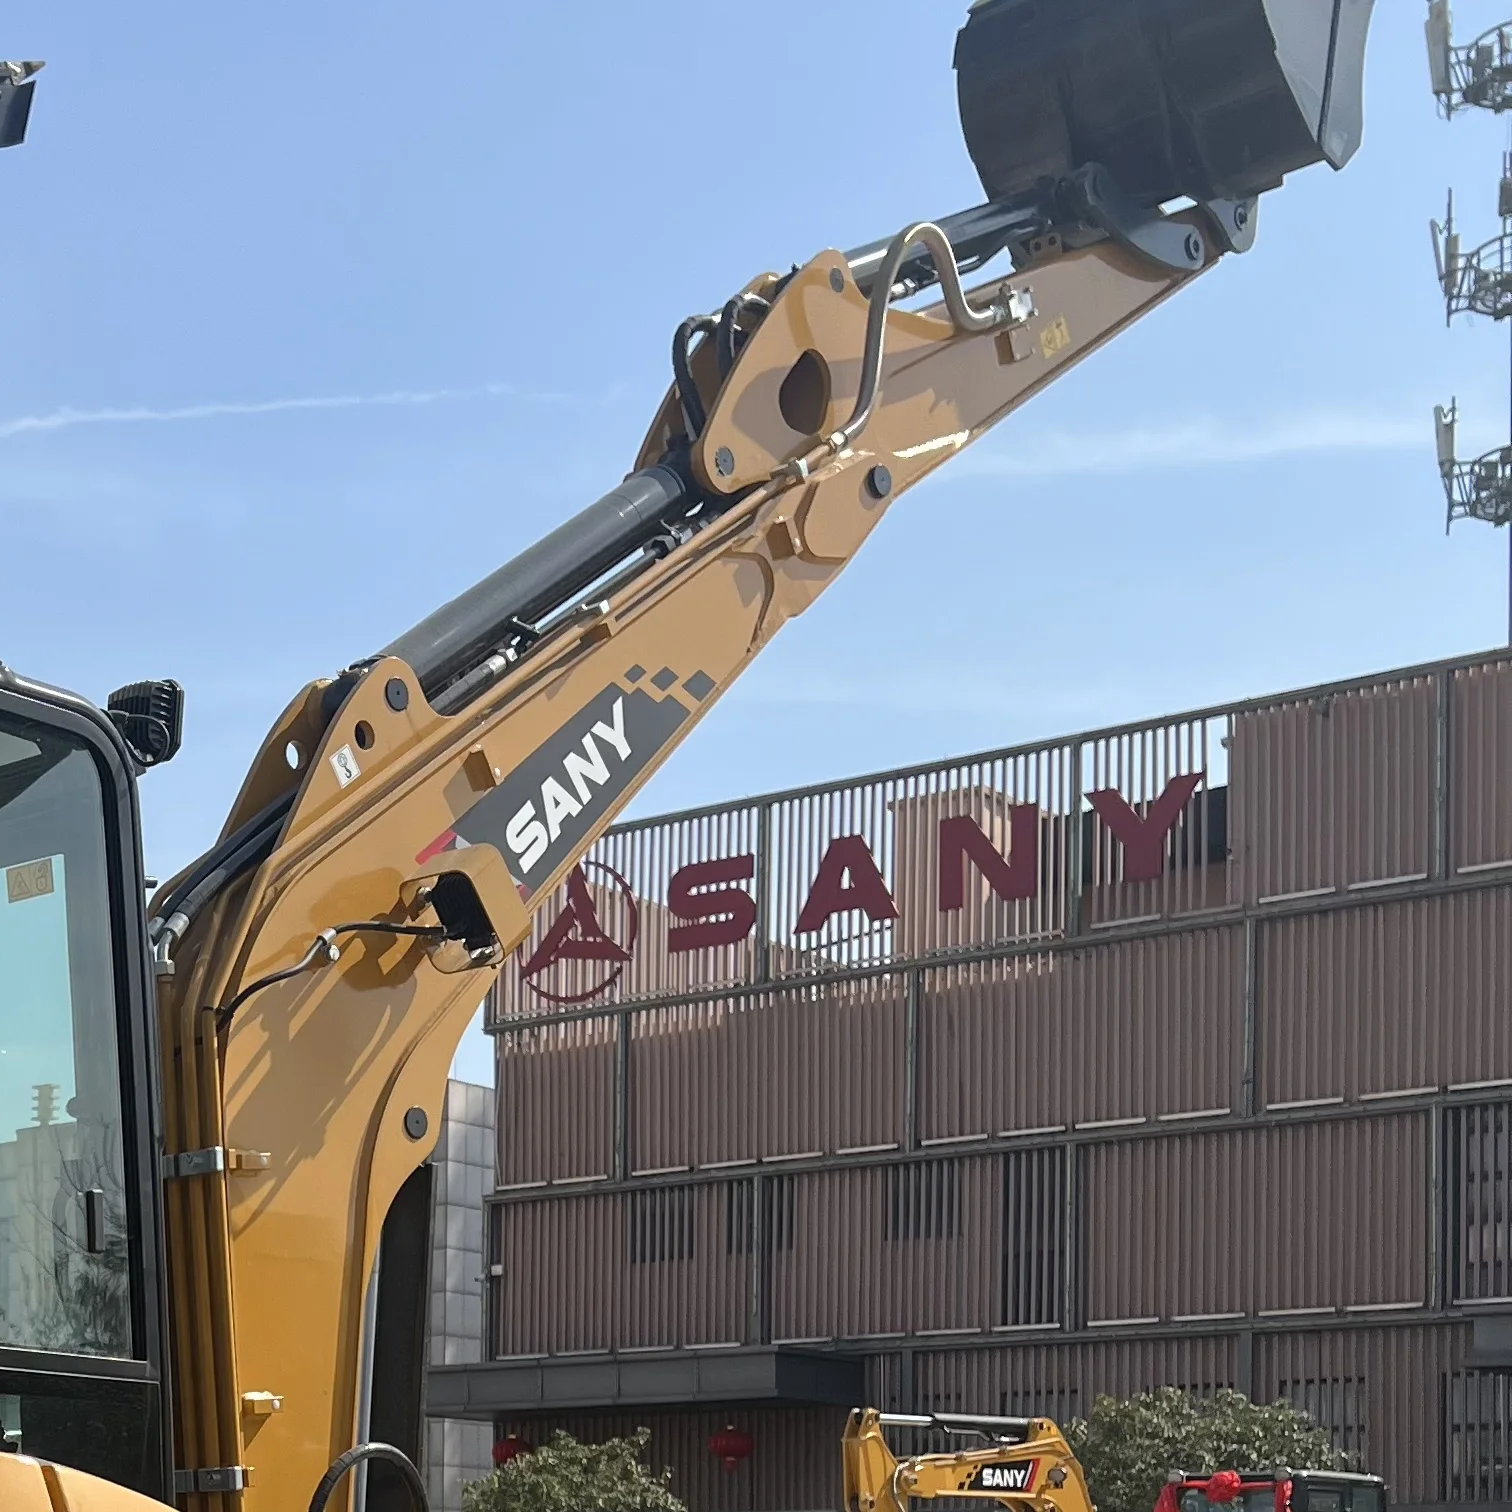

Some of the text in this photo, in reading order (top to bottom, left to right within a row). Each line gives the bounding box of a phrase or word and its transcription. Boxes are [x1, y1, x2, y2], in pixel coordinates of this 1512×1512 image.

[505, 696, 633, 874] SANY
[667, 771, 1205, 953] SANY
[982, 1467, 1026, 1487] SANY
